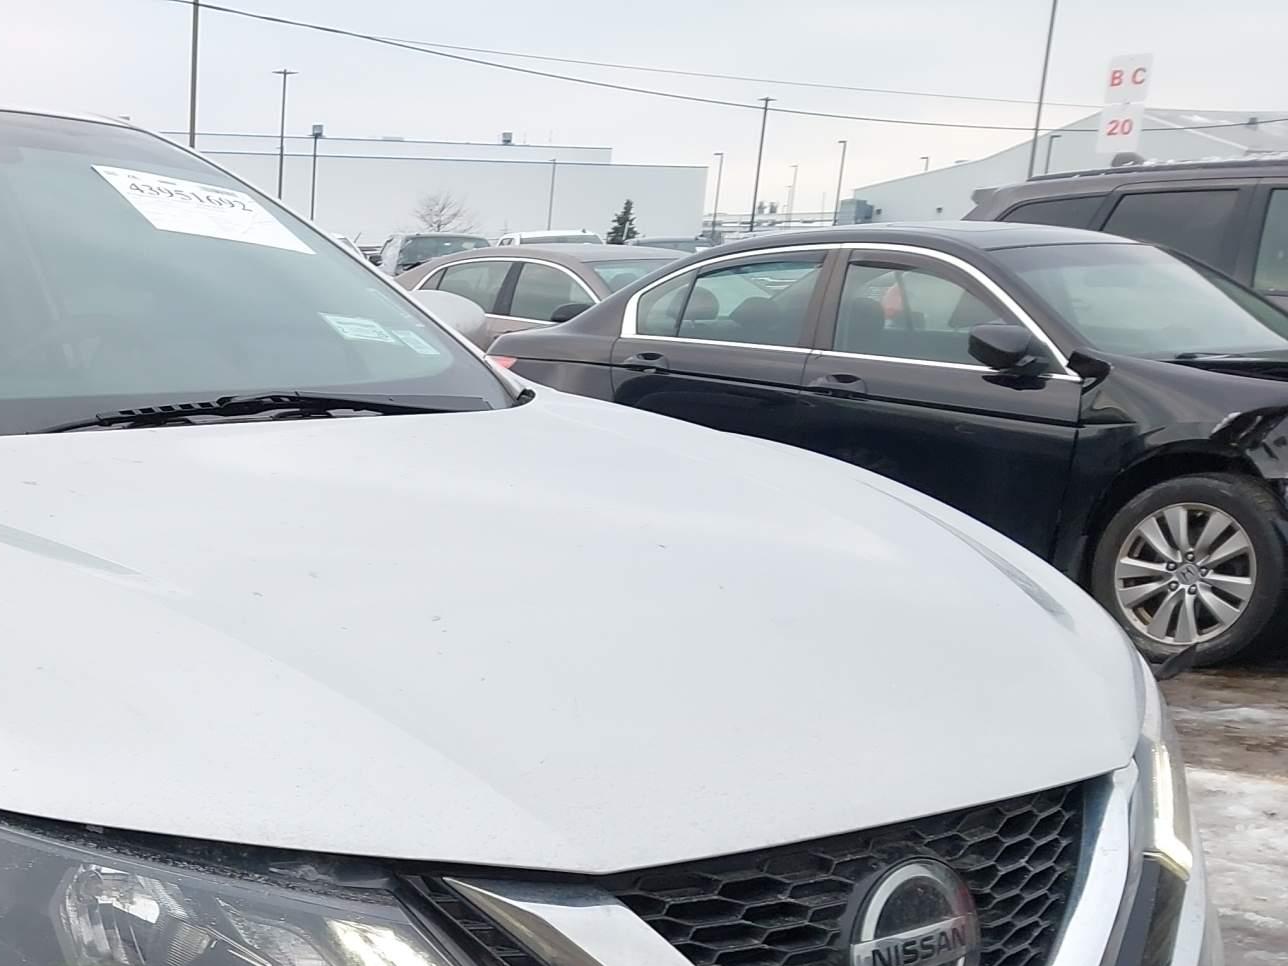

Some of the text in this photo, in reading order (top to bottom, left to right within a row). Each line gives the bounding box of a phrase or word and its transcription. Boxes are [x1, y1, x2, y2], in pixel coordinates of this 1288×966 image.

[1110, 67, 1147, 87] B C
[1106, 118, 1134, 136] 20
[129, 182, 253, 212] 43951692
